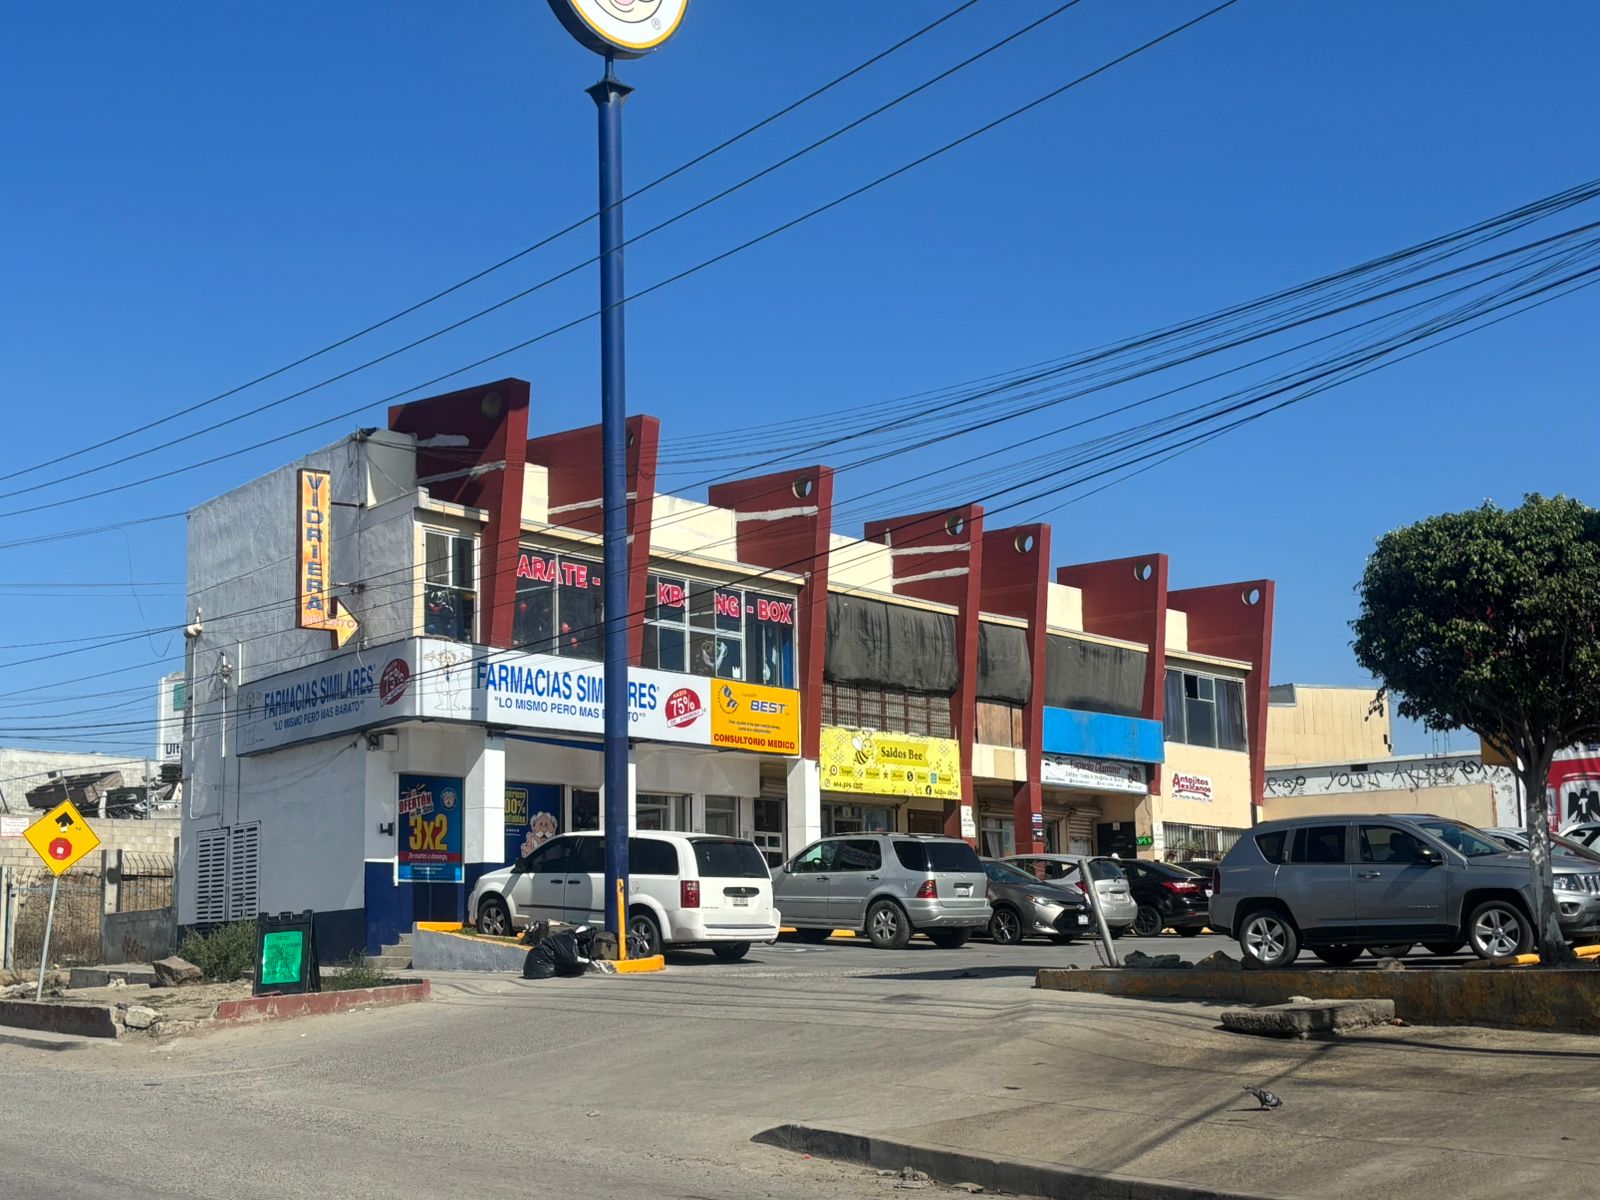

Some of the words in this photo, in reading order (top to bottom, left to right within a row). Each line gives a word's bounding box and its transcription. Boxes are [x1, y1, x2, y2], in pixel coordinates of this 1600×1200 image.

[305, 474, 325, 611] VIDRIERA
[516, 555, 588, 588] ARATE
[757, 599, 793, 626] BOX
[264, 681, 318, 719] FARMACIAS
[320, 666, 374, 703] SIMILARES
[477, 662, 572, 699] FARMACIAS
[576, 674, 657, 711] SIMRES
[515, 699, 548, 713] MISMO
[550, 703, 577, 716] PERO
[579, 706, 600, 719] MAS
[670, 694, 696, 717] 75%
[750, 700, 786, 715] BEST
[284, 717, 303, 729] MISMO
[303, 711, 320, 723] PERO
[320, 708, 334, 720] MAS
[713, 733, 766, 747] CONSULTORIO
[767, 739, 795, 750] MEDICO
[881, 746, 907, 759] Saldos
[908, 749, 923, 761] Bee
[1172, 781, 1211, 793] Mexicanos
[399, 793, 432, 812] OFERTÓN
[505, 797, 526, 816] 00%
[409, 813, 448, 851] 3x2
